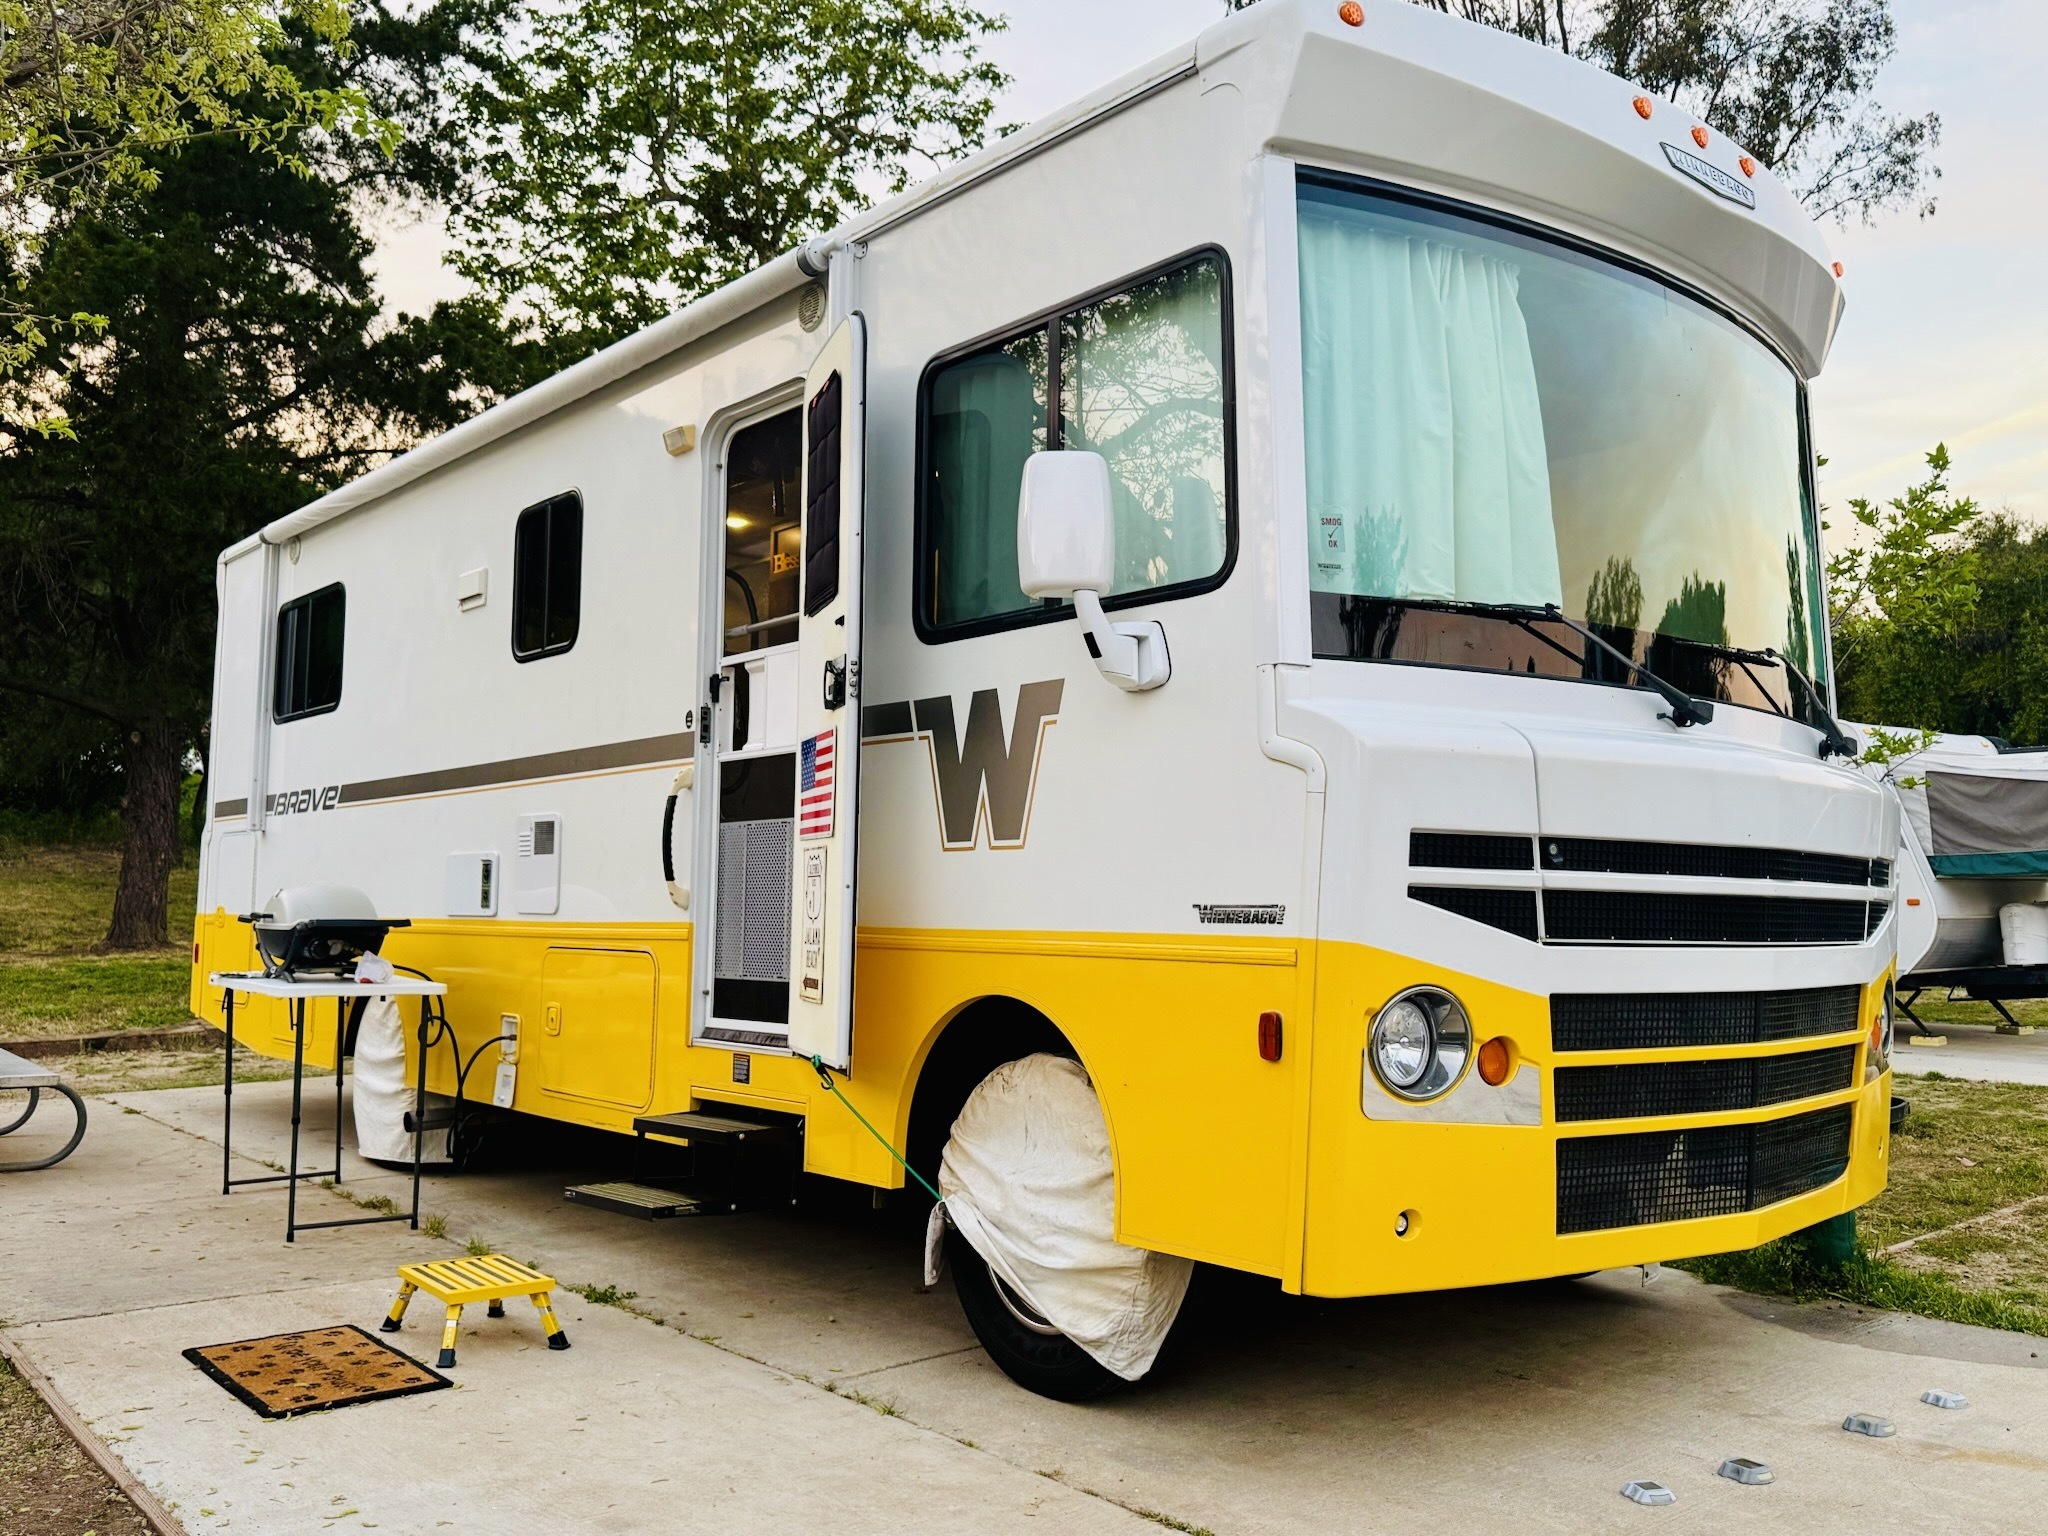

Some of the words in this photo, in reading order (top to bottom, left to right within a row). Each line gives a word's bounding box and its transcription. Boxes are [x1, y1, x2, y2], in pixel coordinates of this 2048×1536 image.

[1672, 149, 1750, 200] WINNEBAGO
[1320, 517, 1342, 526] SMOG
[1328, 540, 1338, 548] OK
[914, 678, 1065, 851] W
